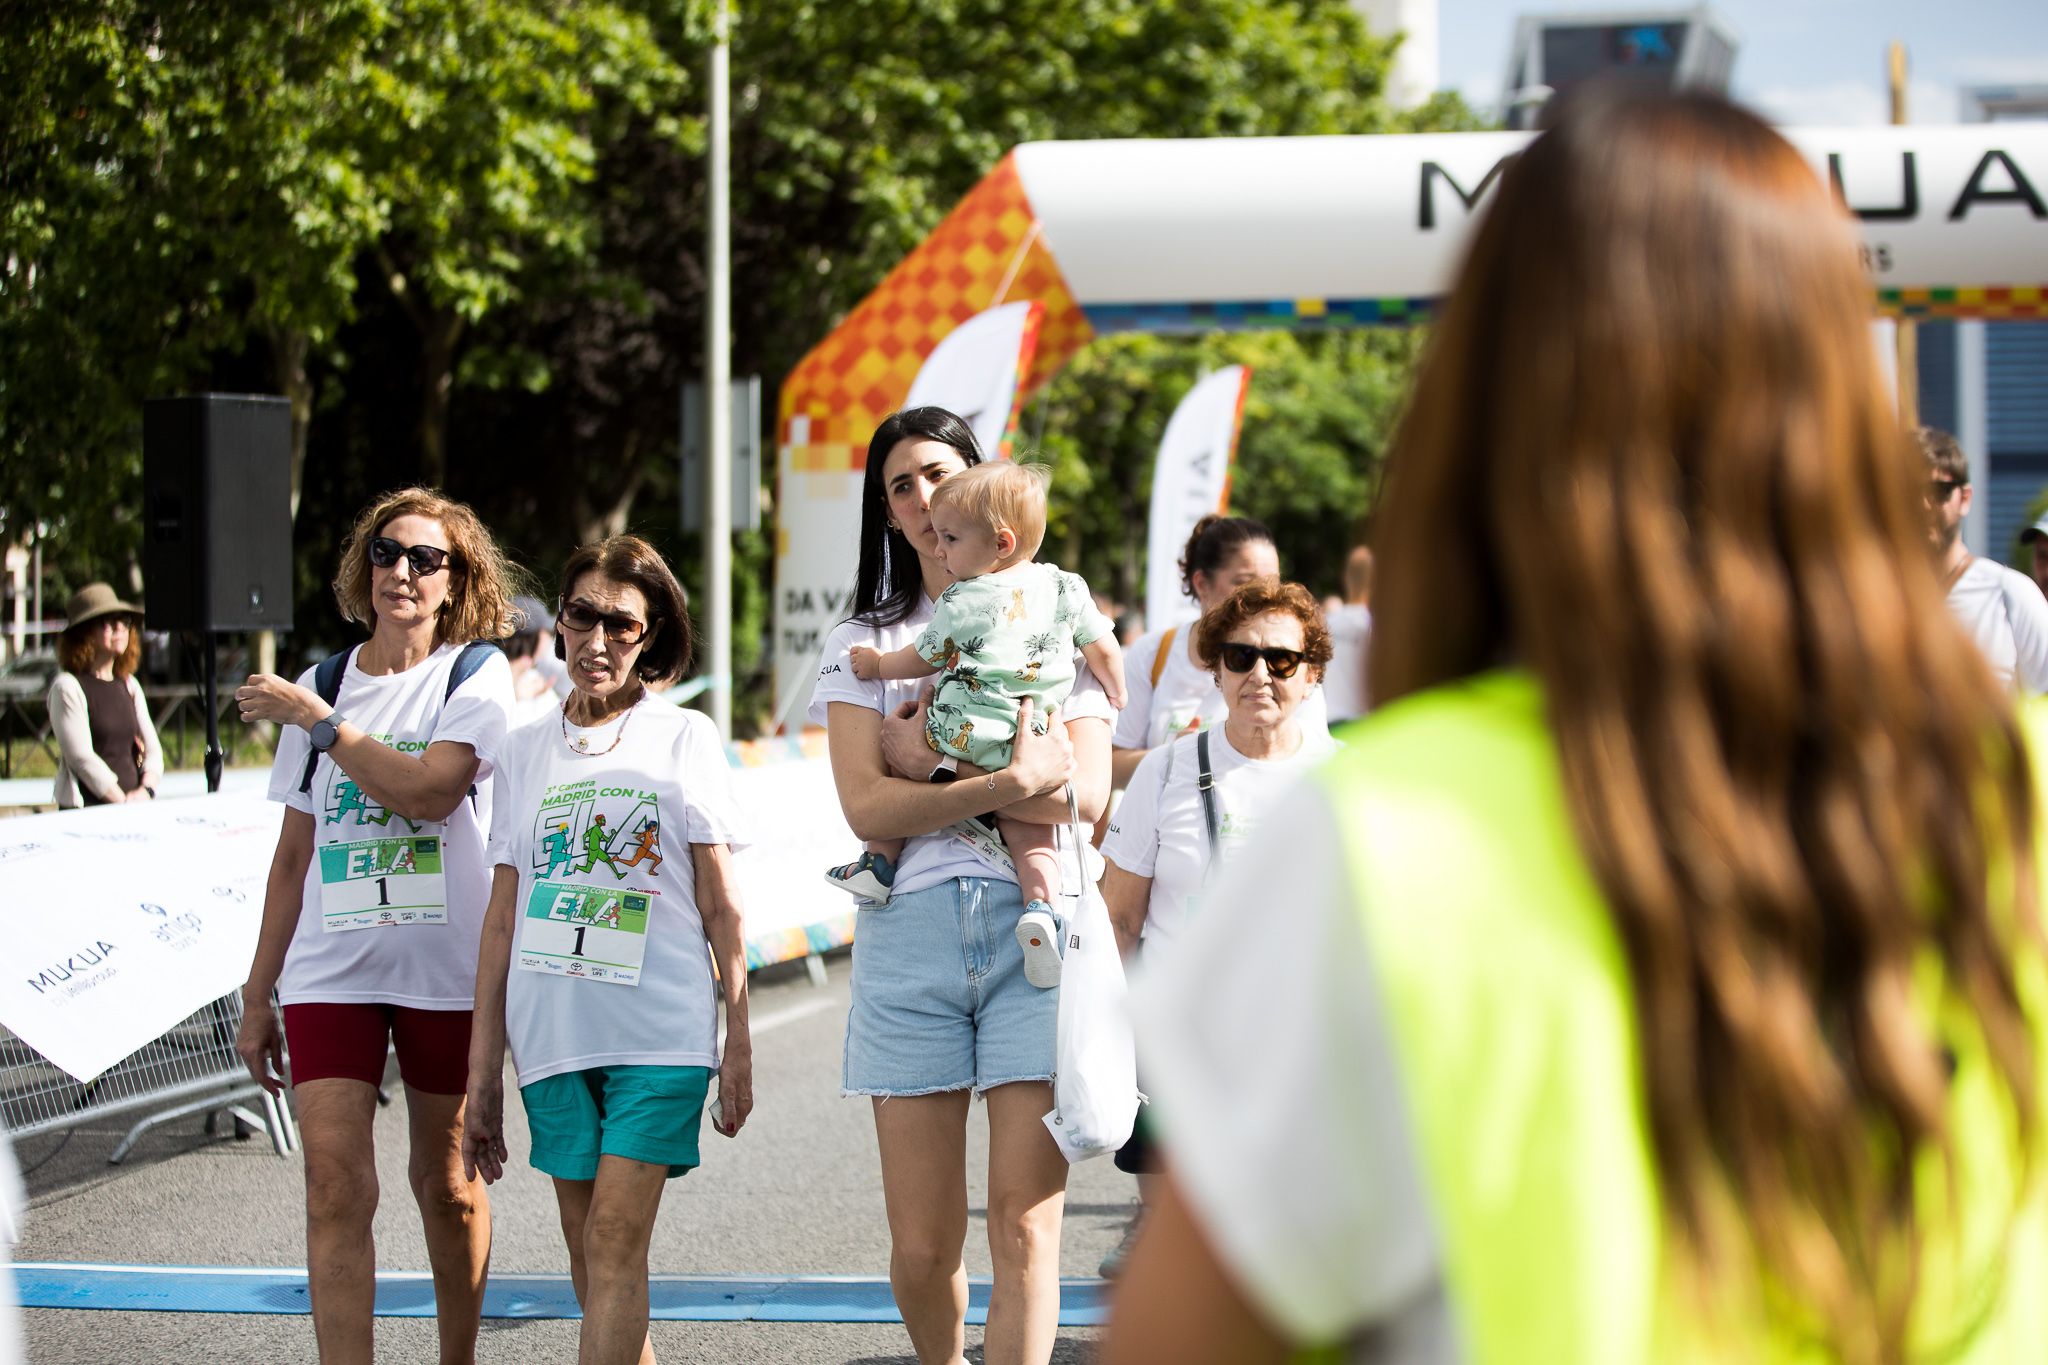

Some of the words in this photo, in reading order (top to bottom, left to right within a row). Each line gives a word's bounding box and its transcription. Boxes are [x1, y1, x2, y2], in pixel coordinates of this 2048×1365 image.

[1419, 149, 2048, 229] MUA
[397, 741, 428, 752] CON
[541, 789, 597, 808] MADRID
[600, 787, 635, 798] CON
[638, 791, 657, 801] LA
[559, 780, 596, 792] Carrera
[348, 840, 379, 850] MADRID
[533, 799, 663, 869] ELA
[346, 845, 417, 880] ELA
[375, 877, 391, 906] 1
[561, 884, 589, 894] MADRID
[589, 887, 608, 896] CON
[608, 889, 619, 897] LA
[547, 891, 619, 929] ELA
[571, 926, 586, 957] 1
[28, 941, 118, 994] MUKUA
